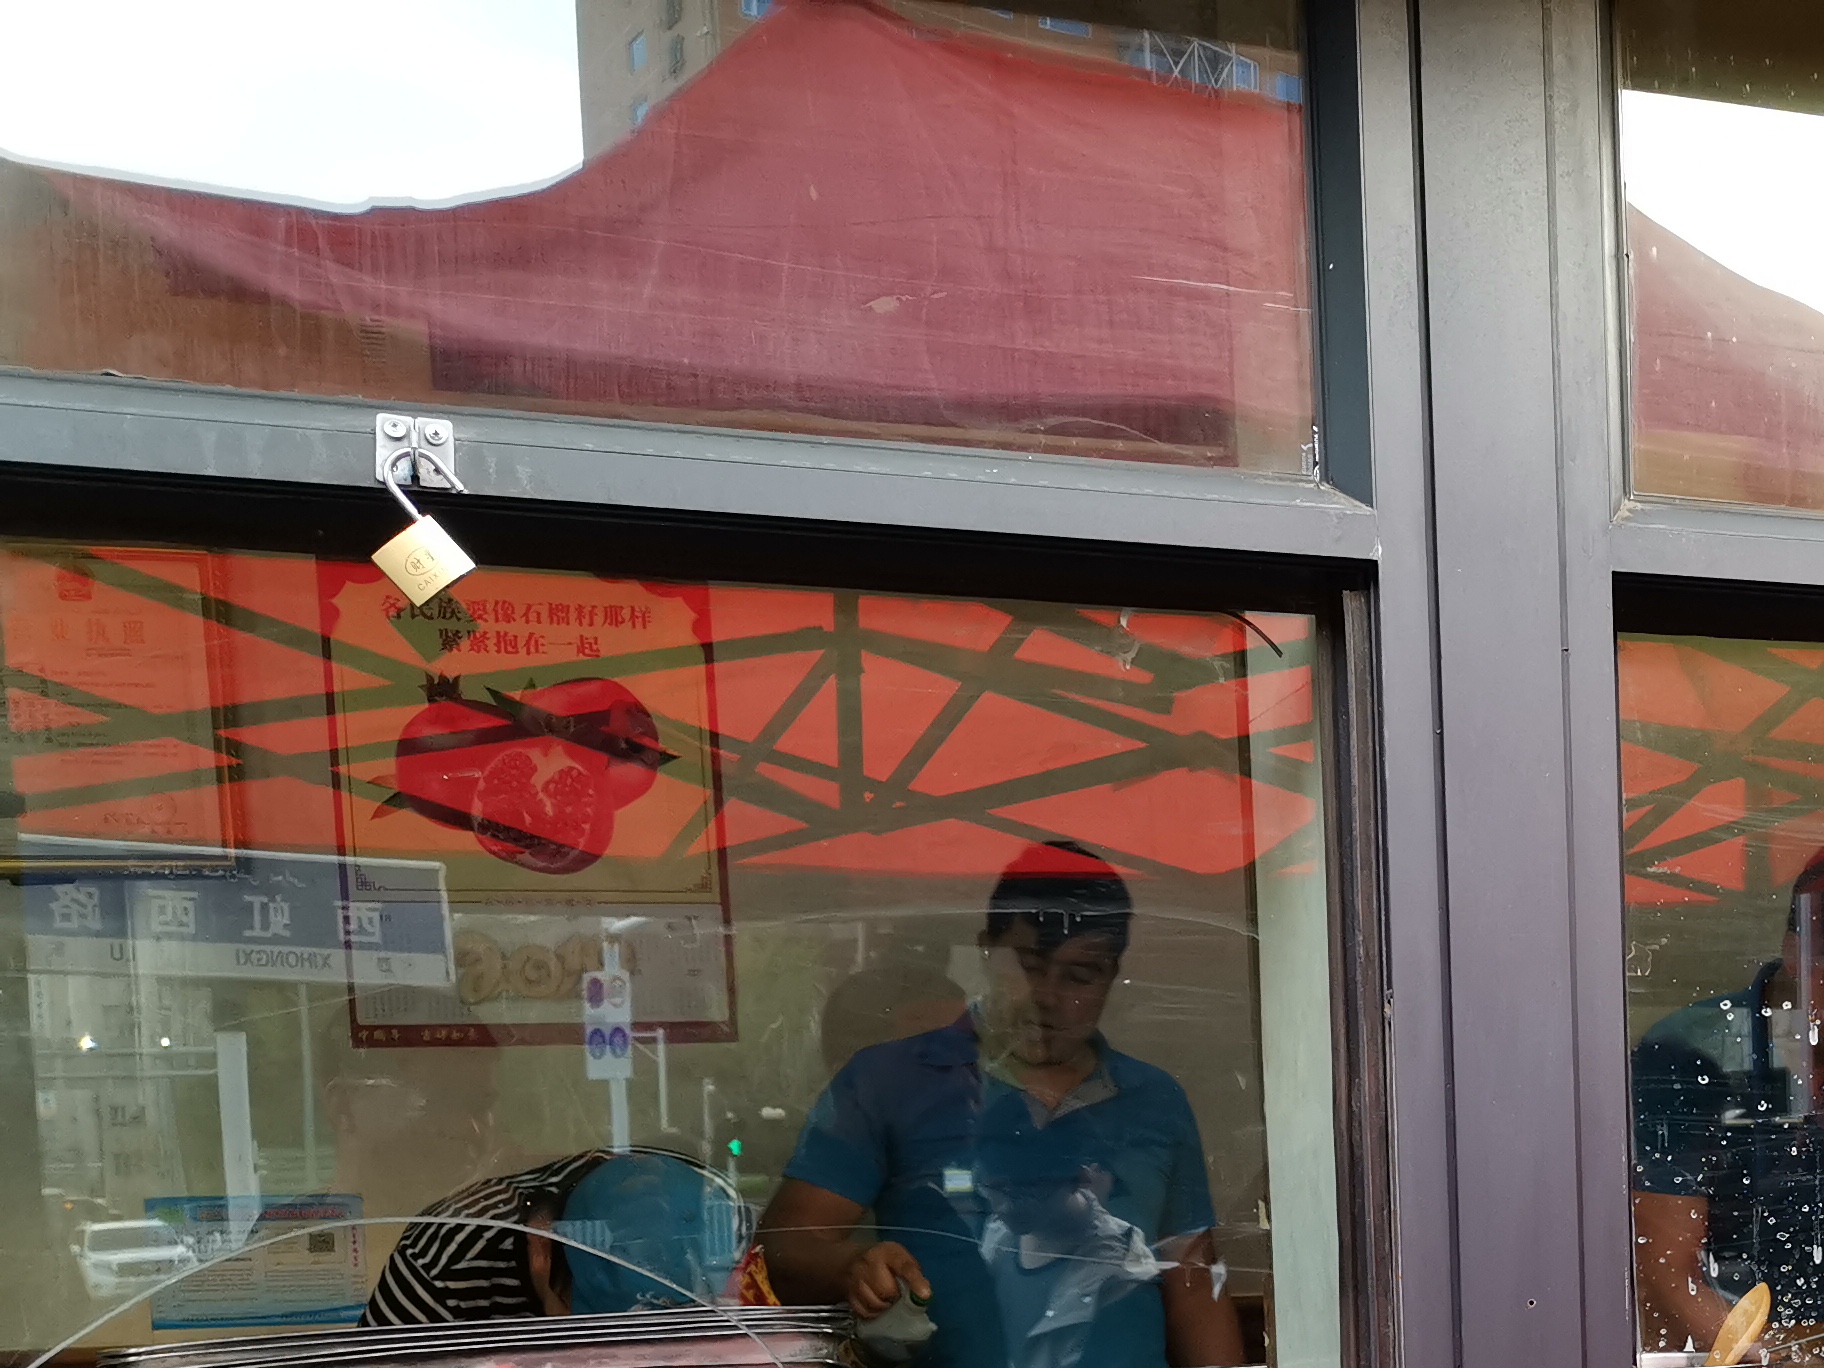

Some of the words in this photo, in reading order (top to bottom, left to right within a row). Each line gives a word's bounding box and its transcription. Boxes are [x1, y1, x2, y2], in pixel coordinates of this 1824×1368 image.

[417, 565, 447, 591] CAIX
[438, 626, 601, 659] 紧紧抱在一起
